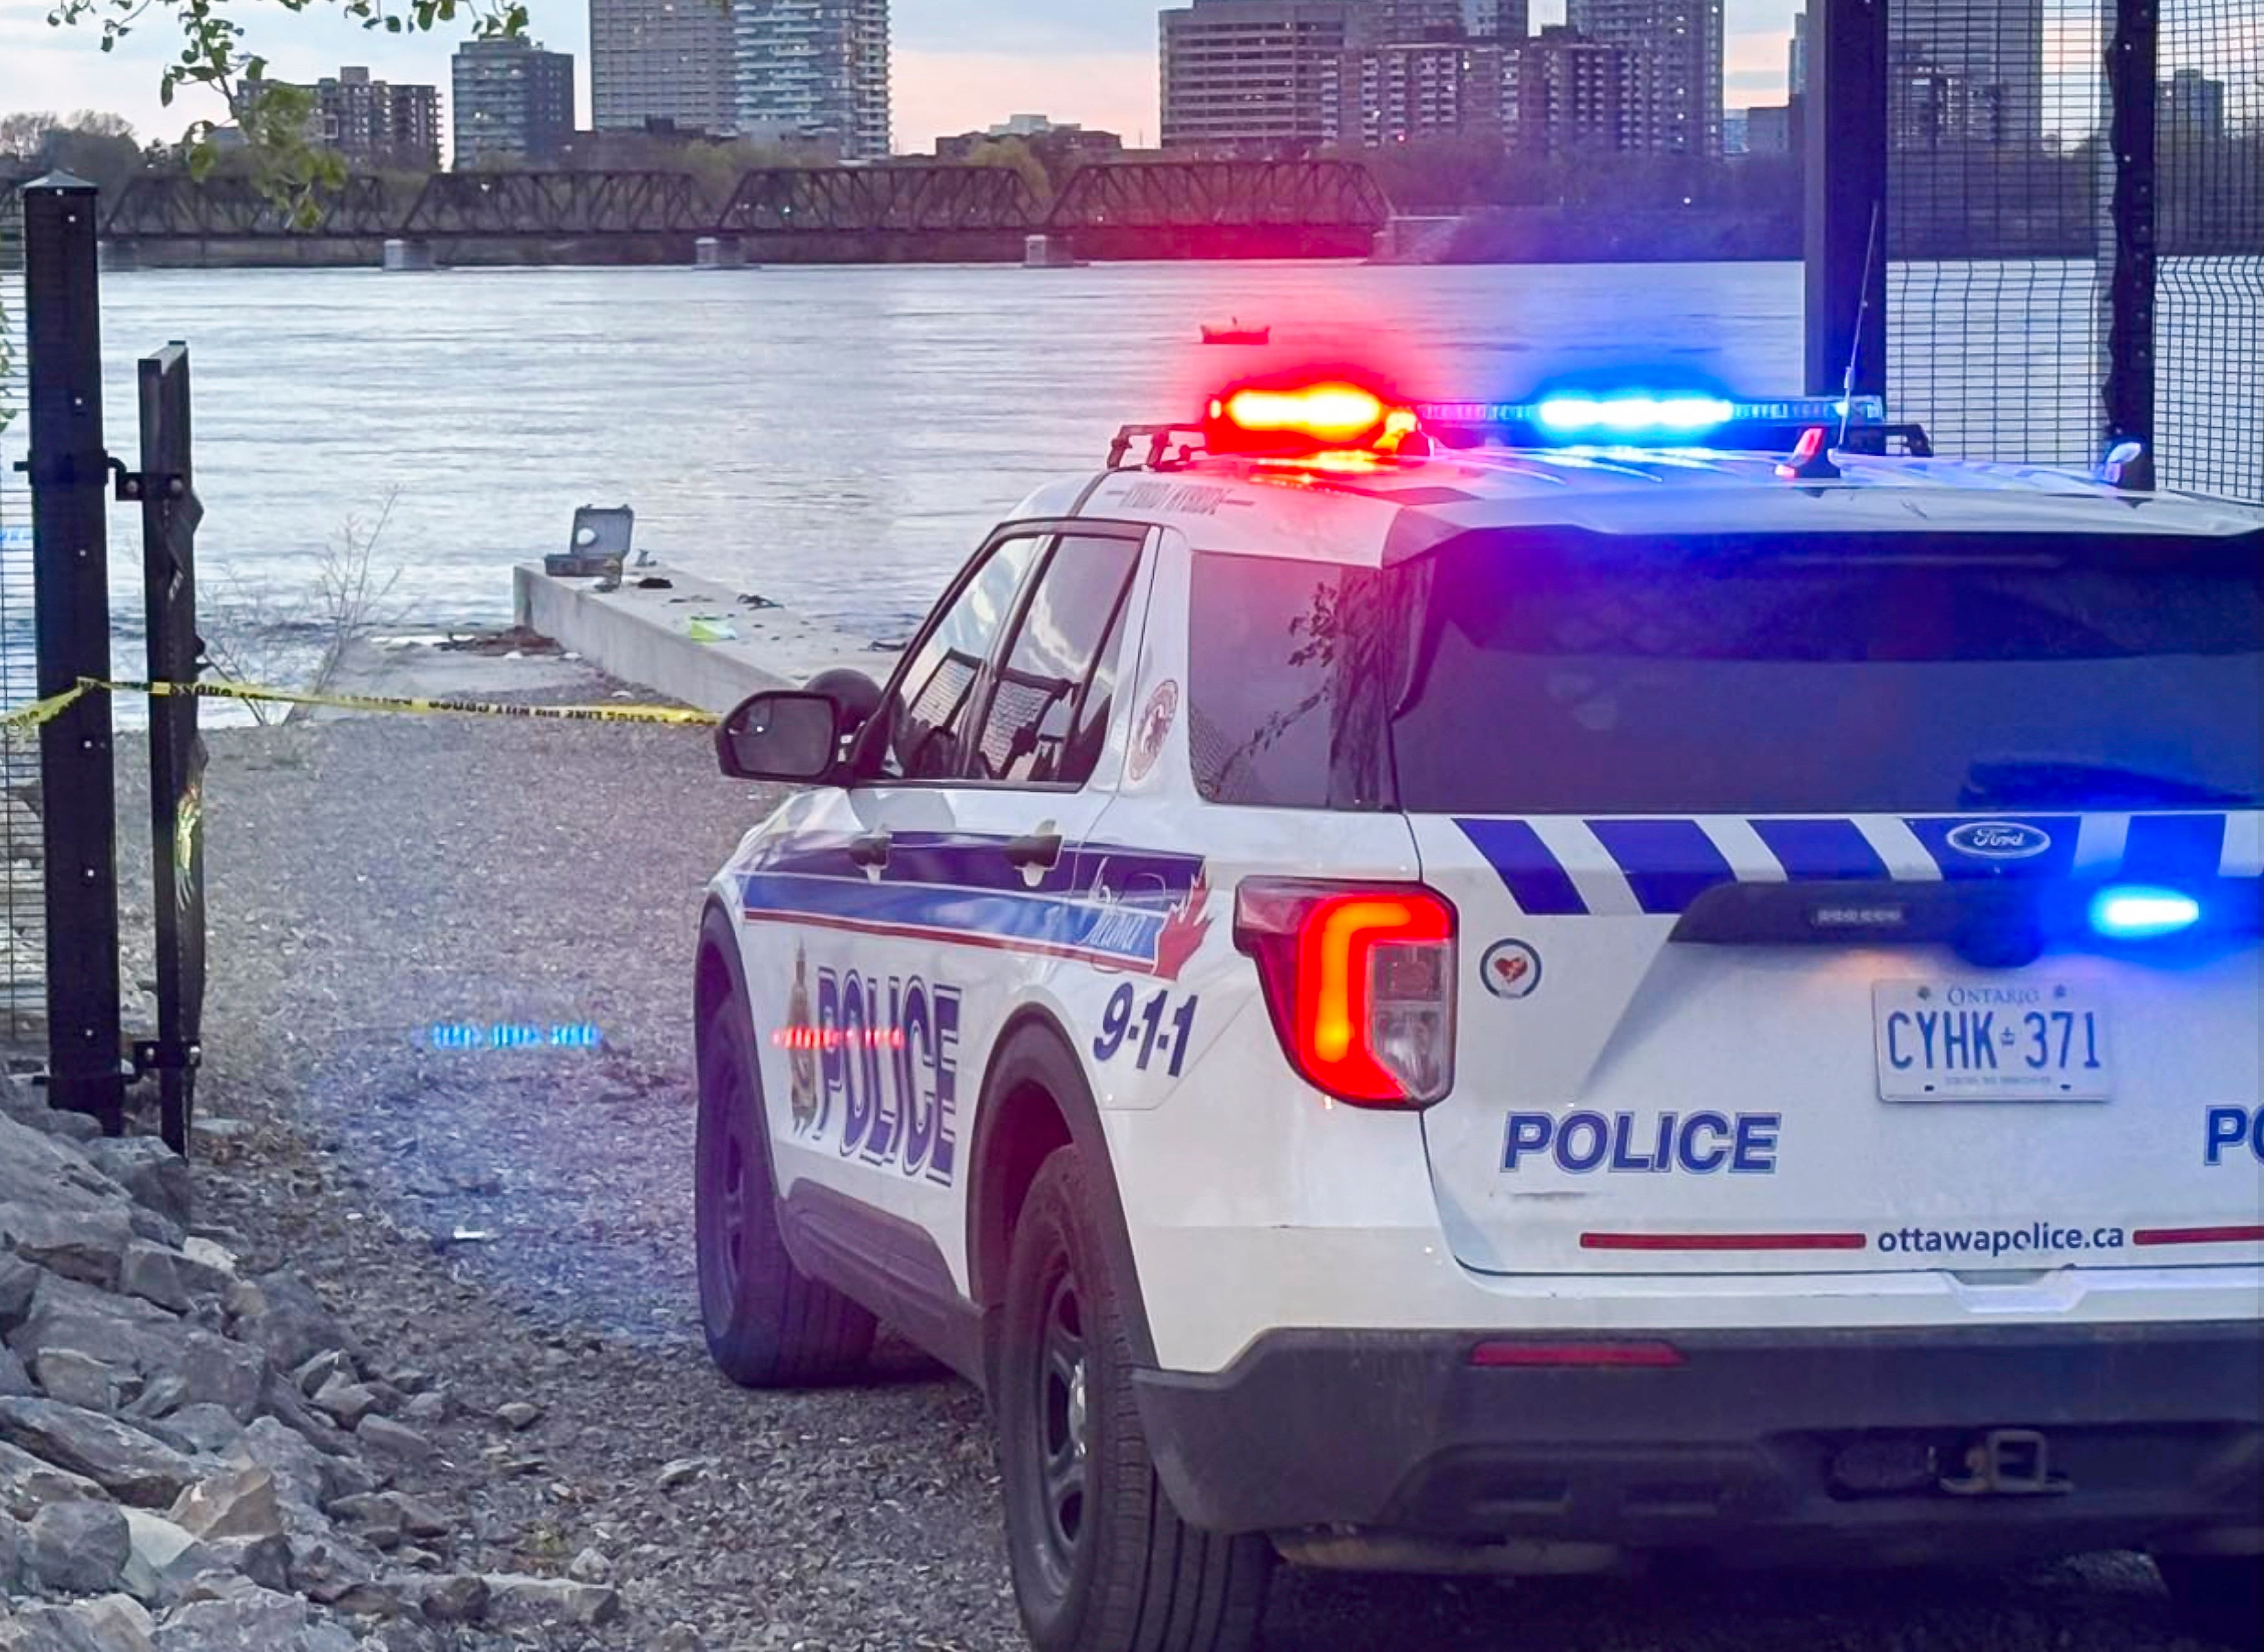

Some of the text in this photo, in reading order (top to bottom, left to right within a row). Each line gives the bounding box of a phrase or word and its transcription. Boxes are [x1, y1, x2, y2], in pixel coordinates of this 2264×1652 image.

[1973, 828, 2025, 847] Ford
[1948, 987, 2039, 1006] ONTARIO
[1094, 982, 1198, 1077] 9-1-1
[1887, 1010, 2101, 1069] CYHK 371
[812, 967, 961, 1187] POLICE
[1501, 1110, 1780, 1174] POLICE
[1878, 1222, 2124, 1257] ottawapolice.ca
